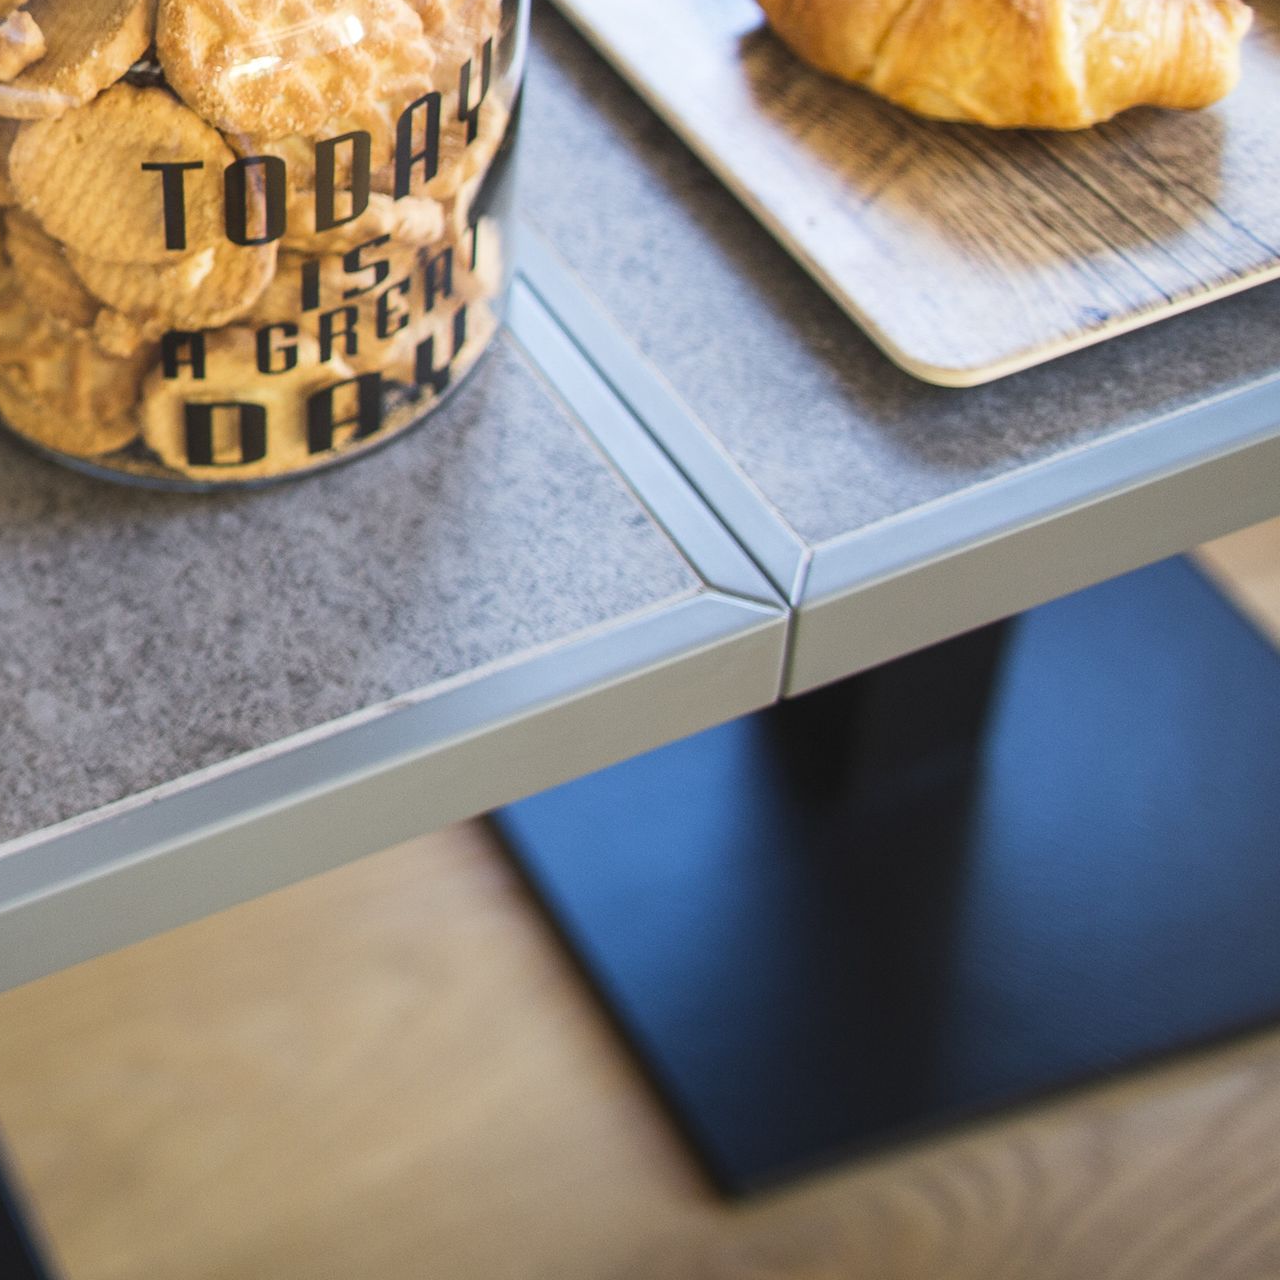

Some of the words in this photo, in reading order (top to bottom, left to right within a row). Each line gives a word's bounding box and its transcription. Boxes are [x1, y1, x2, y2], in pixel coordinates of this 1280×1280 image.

[141, 35, 493, 251] TODAY
[161, 329, 207, 381] A
[255, 216, 483, 377] GREAT
[301, 233, 391, 313] IS
[183, 303, 467, 469] DAY
